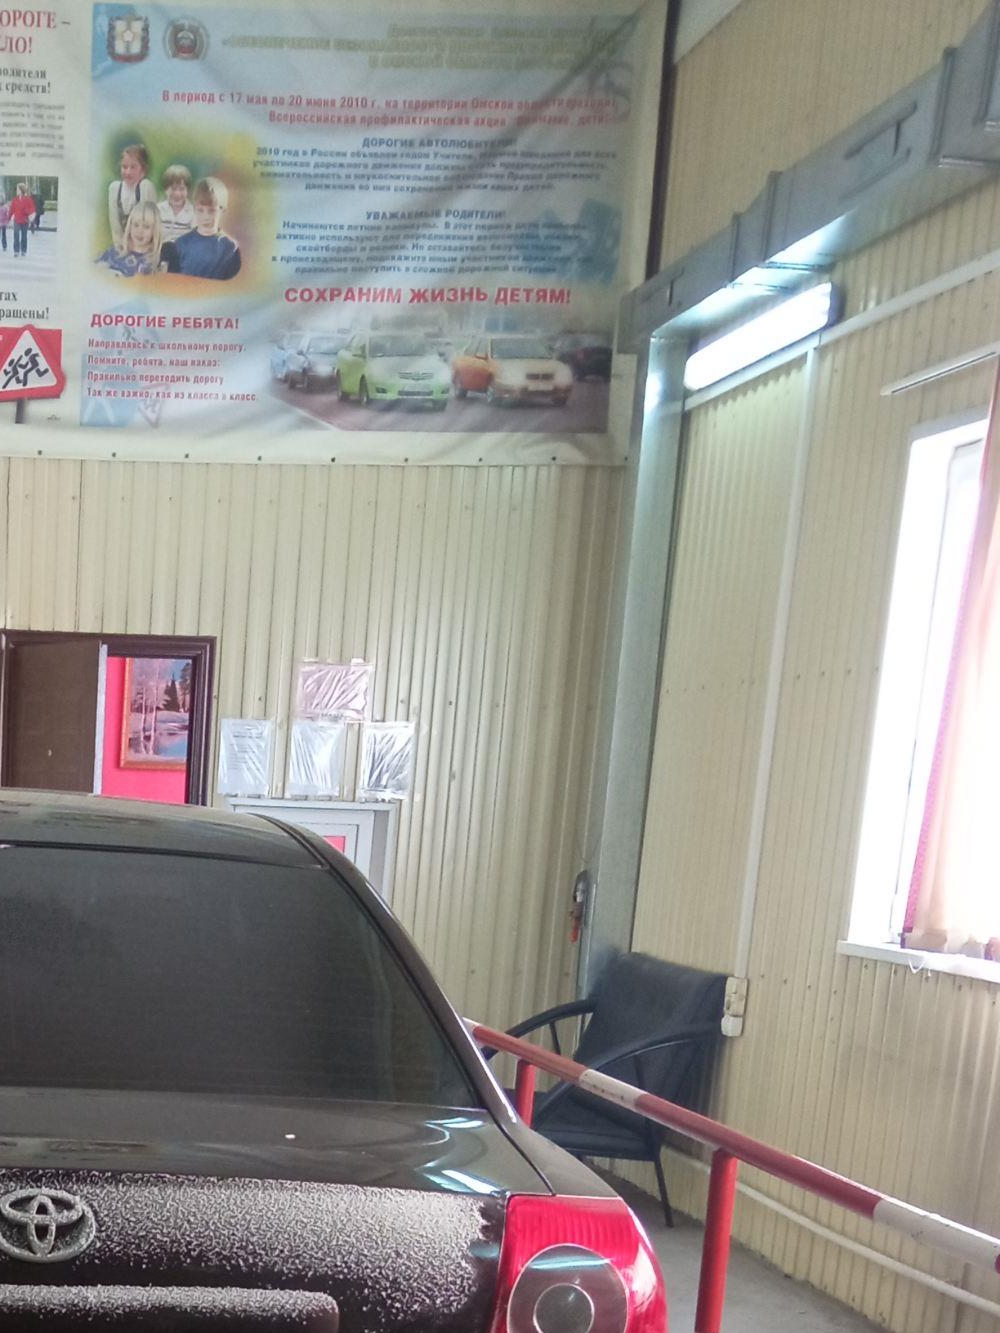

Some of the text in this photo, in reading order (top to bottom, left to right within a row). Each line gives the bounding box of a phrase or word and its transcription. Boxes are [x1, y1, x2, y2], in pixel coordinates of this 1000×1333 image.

[5, 82, 51, 94] средств!
[174, 92, 215, 105] период
[340, 96, 368, 109] 2010
[284, 287, 571, 305] СОХРАНИМ ЖИЗНЬ ДЕТЯМ!
[90, 314, 239, 329] ДОРОГИЕ РЕБЯТА!
